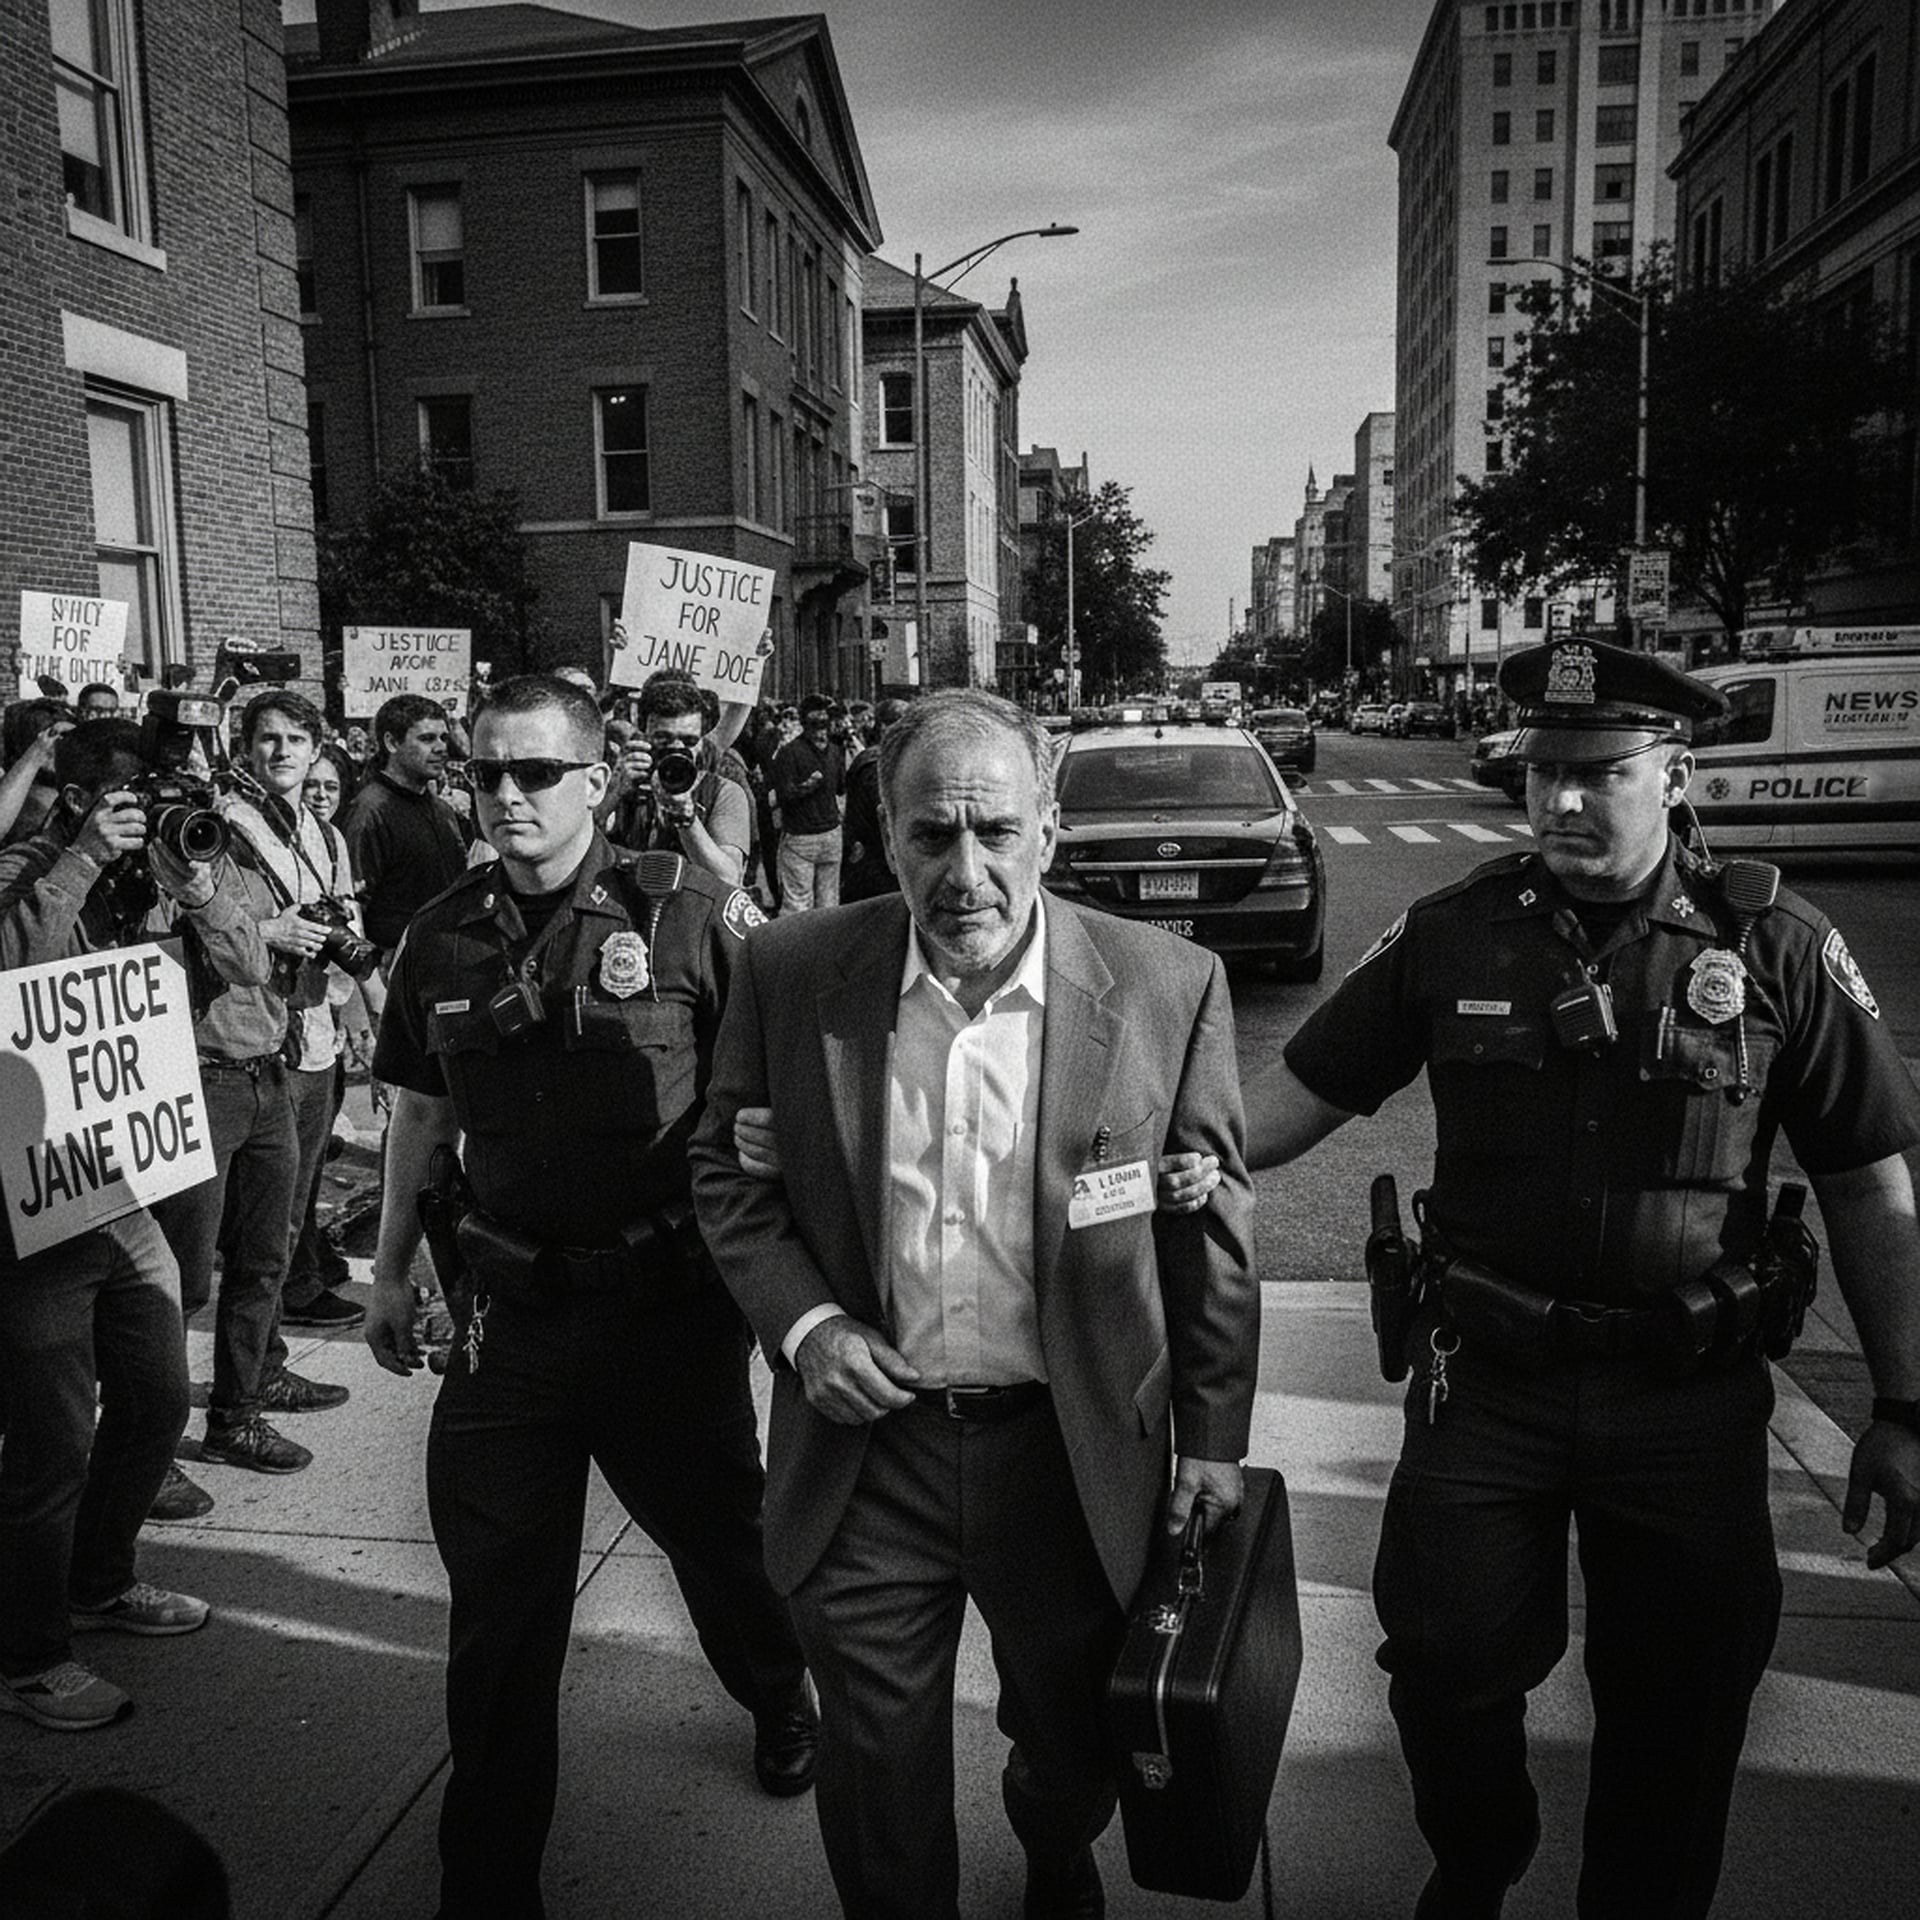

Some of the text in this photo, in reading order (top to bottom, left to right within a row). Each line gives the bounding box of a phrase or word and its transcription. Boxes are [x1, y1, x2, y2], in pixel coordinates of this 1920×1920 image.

[659, 555, 764, 605] JUSTICE
[678, 602, 721, 637] FOR
[637, 635, 759, 685] JANE DOE
[1825, 690, 1919, 712] NEWS
[1749, 776, 1869, 800] POLICE
[11, 955, 168, 1051] JUSTICE
[67, 1034, 146, 1111] FOR
[20, 1093, 202, 1218] JANE DOE
